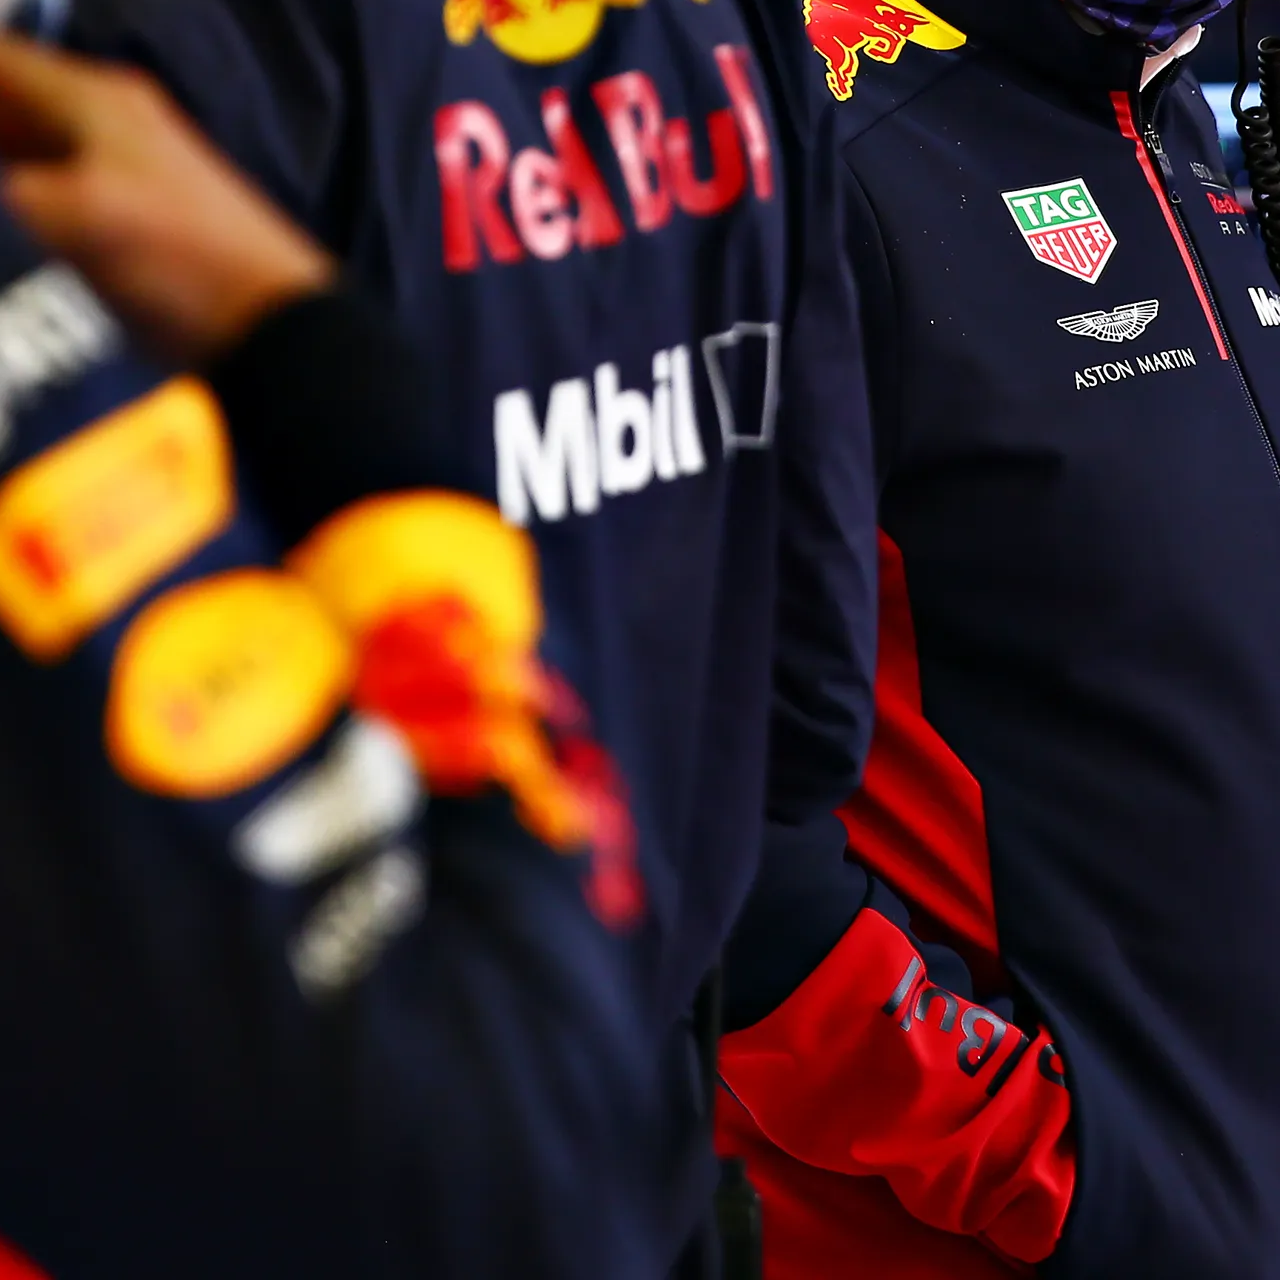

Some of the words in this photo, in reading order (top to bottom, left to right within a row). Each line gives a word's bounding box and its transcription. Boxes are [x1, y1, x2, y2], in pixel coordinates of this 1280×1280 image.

[1011, 187, 1092, 227] TAG
[1030, 223, 1109, 275] HEUER
[1074, 358, 1135, 390] ASTON
[1135, 347, 1197, 374] MARTIN
[493, 343, 707, 527] Mbil
